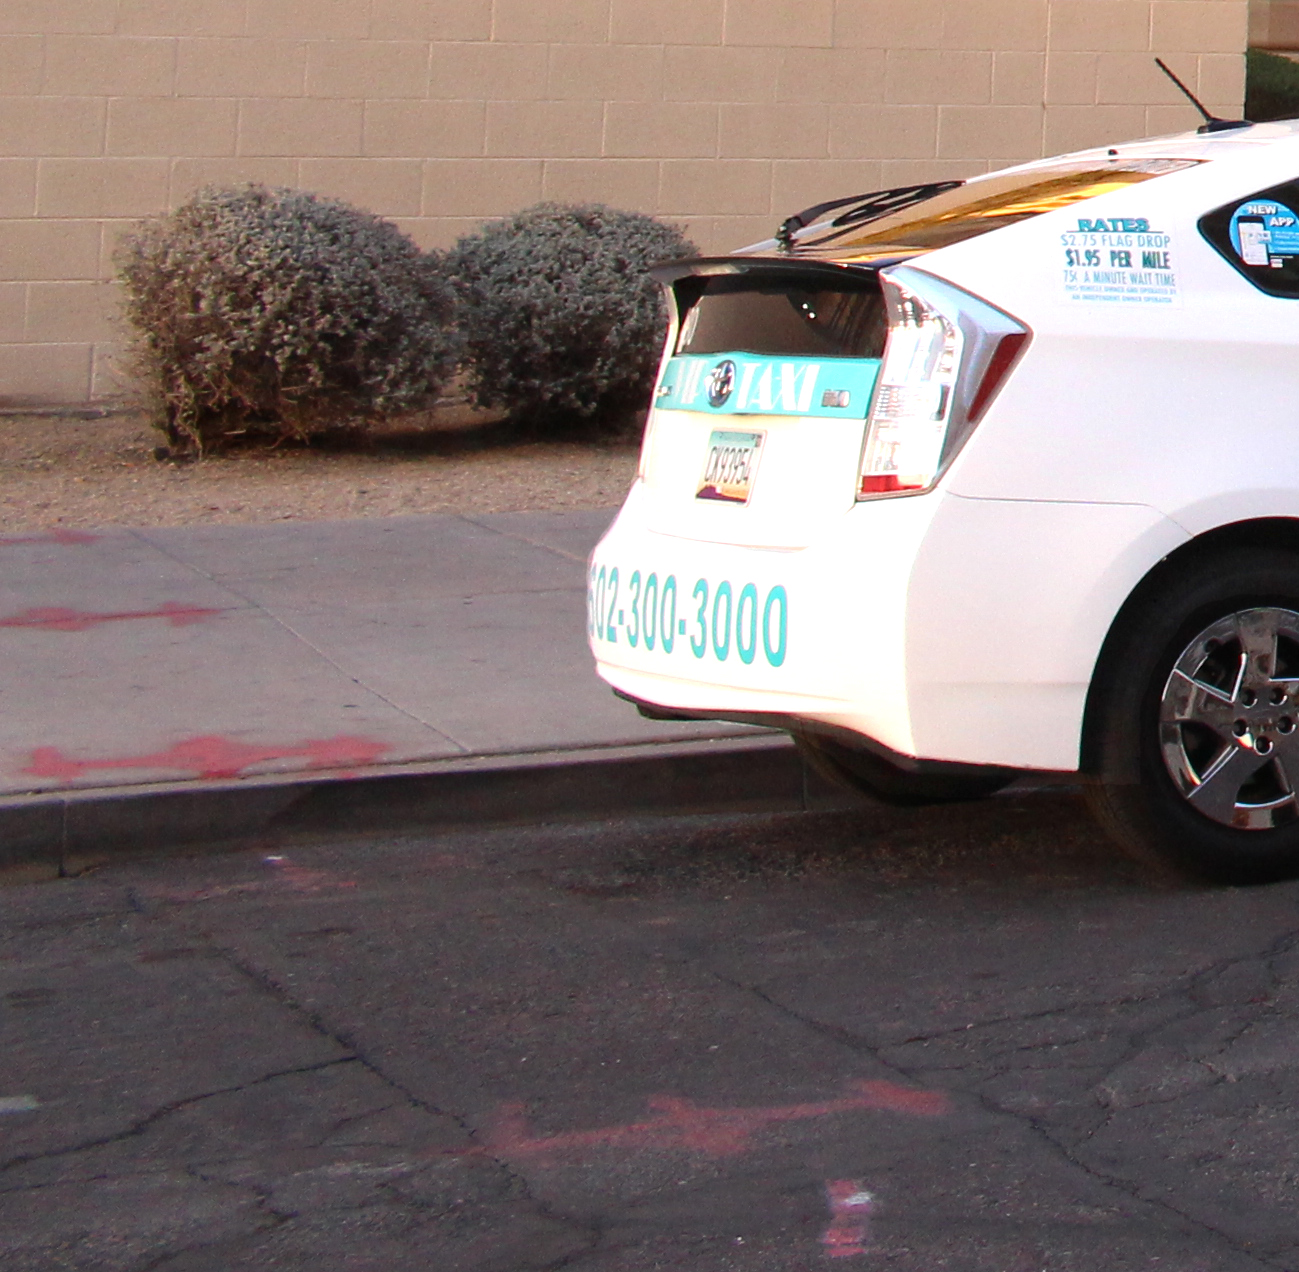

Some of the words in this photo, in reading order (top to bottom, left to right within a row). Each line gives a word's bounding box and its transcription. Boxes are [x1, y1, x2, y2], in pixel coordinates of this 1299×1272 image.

[1248, 205, 1277, 215] NEW
[1077, 217, 1151, 232] RATES
[1270, 217, 1295, 227] APP
[1060, 234, 1097, 247] $2.75
[1101, 235, 1133, 247] FLAG
[1137, 235, 1171, 248] DROP
[1065, 248, 1101, 268] $1.95
[1110, 249, 1133, 268] PER
[1142, 250, 1171, 269] MILE
[1093, 271, 1127, 285] MINUTE
[1129, 272, 1152, 286] WAIT
[1155, 272, 1176, 287] TIME
[735, 361, 821, 412] TAXI
